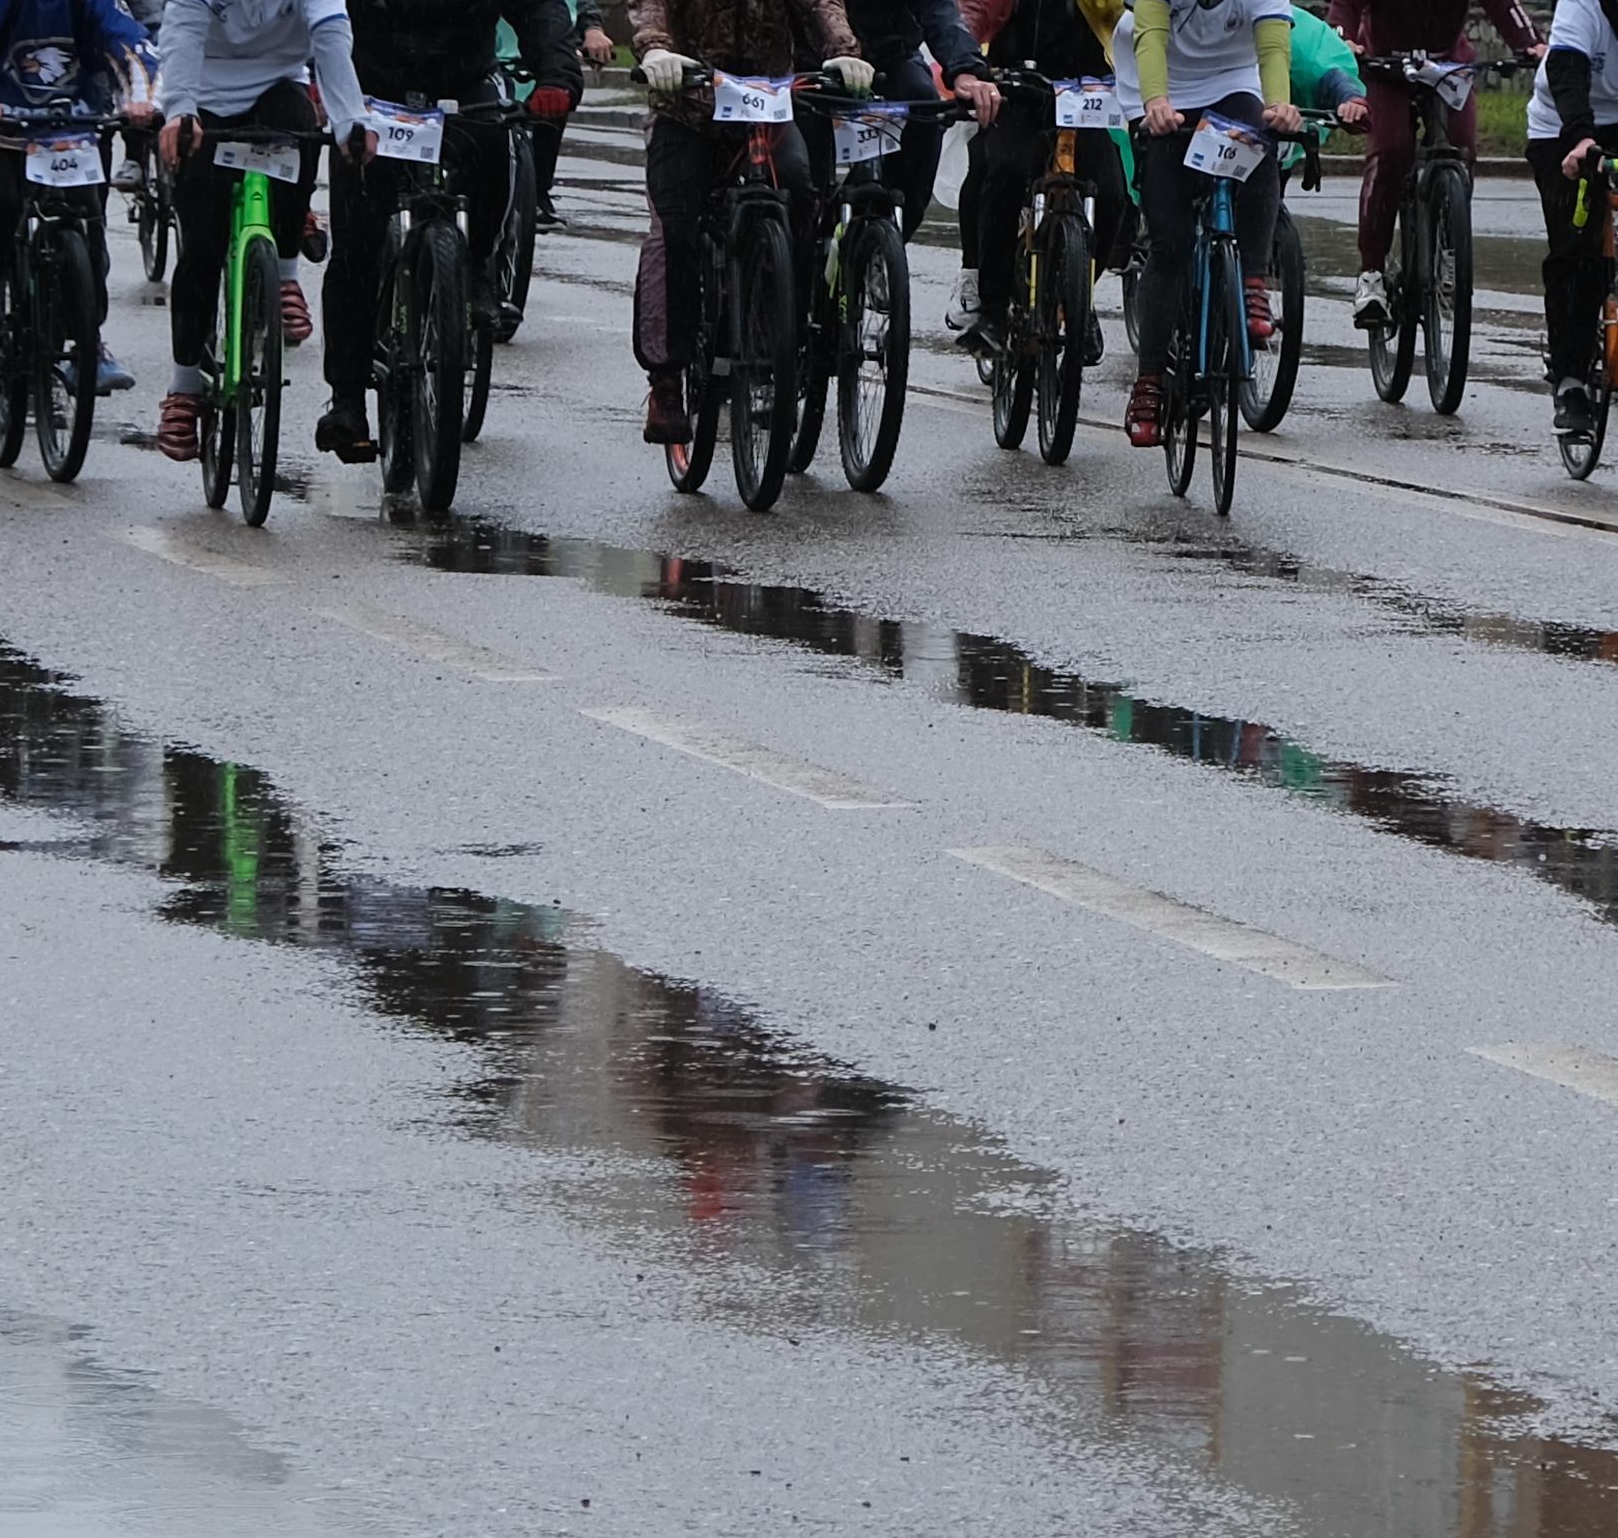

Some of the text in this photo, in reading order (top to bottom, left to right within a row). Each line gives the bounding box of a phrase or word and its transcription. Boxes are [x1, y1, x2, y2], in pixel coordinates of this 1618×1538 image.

[742, 93, 765, 111] 661
[1082, 97, 1103, 111] 212
[388, 127, 415, 141] 109
[50, 158, 79, 172] 404
